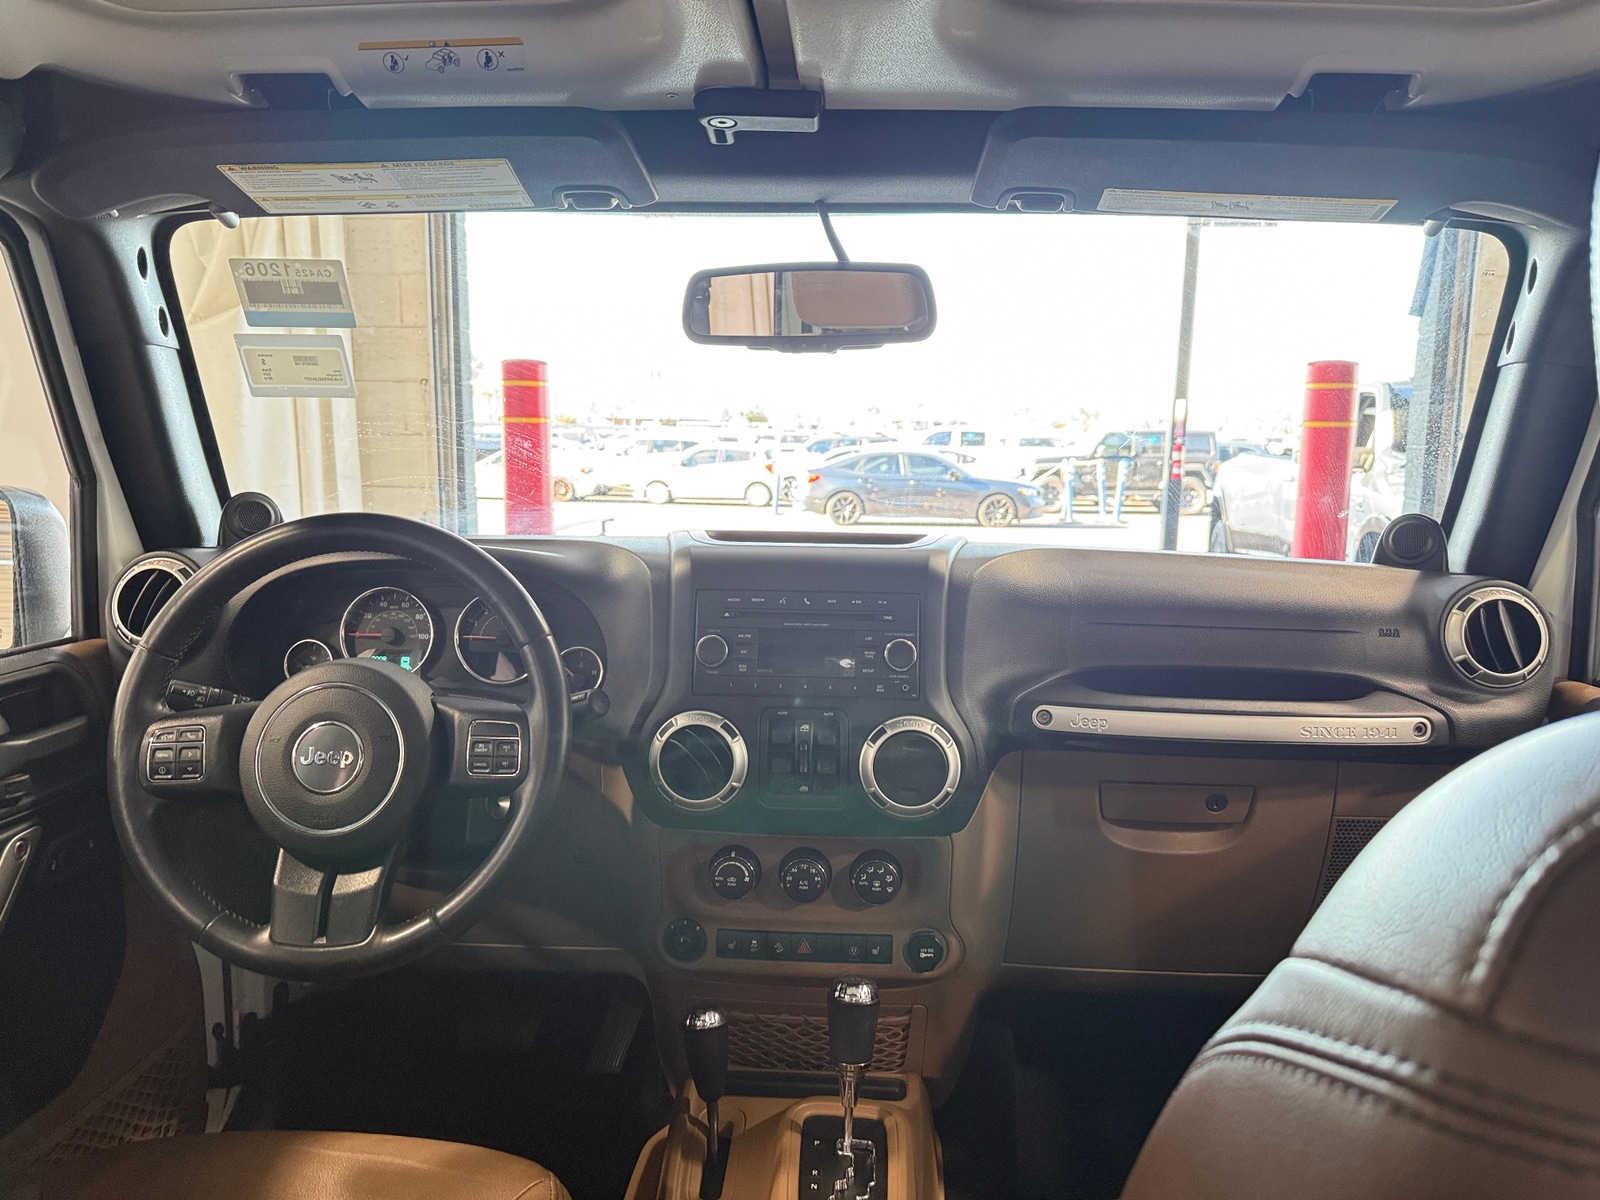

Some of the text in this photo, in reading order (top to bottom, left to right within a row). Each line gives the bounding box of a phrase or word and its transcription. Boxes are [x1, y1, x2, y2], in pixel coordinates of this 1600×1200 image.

[897, 720, 923, 728] Jeep
[1070, 714, 1108, 731] Jeep
[1300, 726, 1397, 738] SINCE 1941
[300, 746, 354, 768] Jeep
